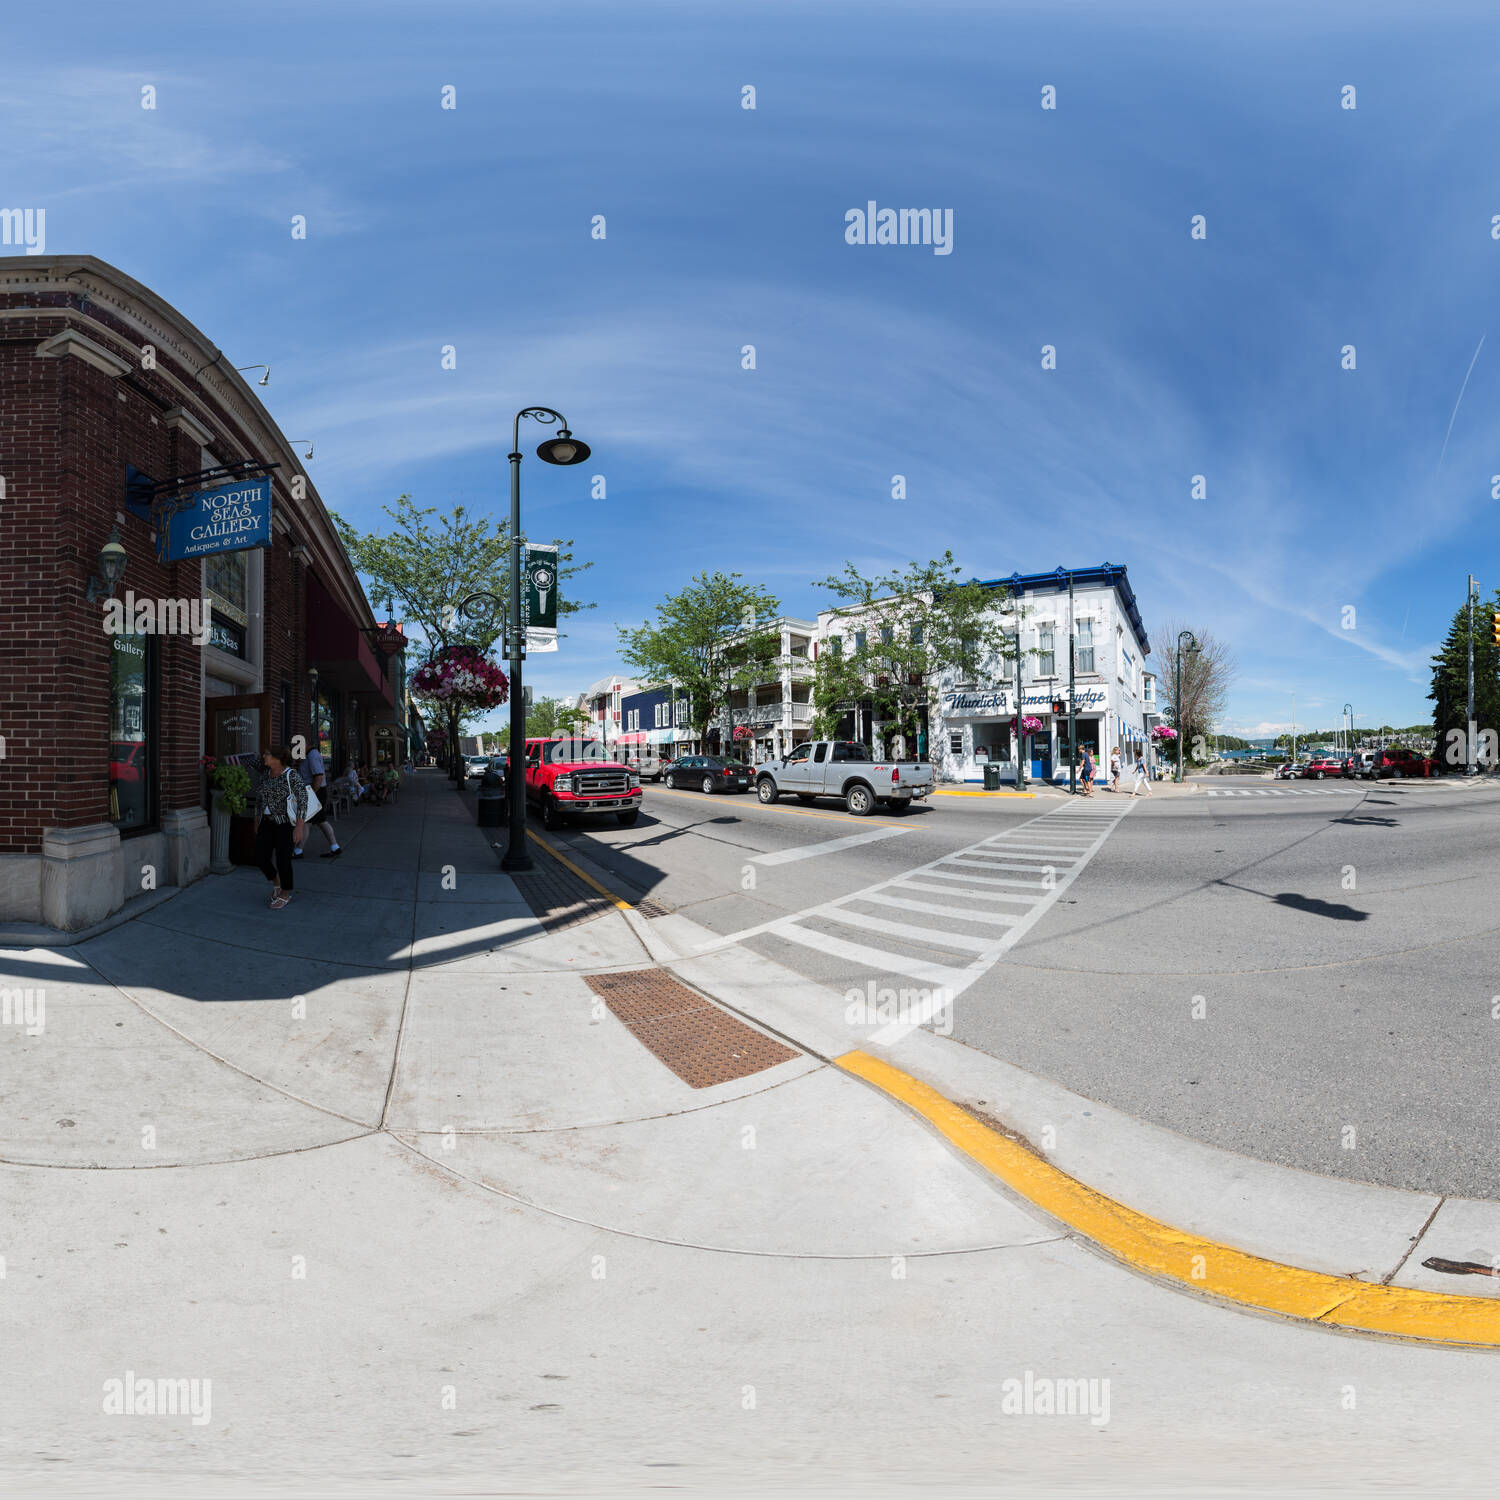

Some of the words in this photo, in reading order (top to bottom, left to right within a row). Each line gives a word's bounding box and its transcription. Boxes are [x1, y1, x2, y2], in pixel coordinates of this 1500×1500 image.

[202, 488, 262, 511] NORTH
[211, 503, 252, 522] SEAS
[190, 515, 262, 540] GALLERY
[184, 542, 220, 553] Antiques
[223, 538, 231, 546] &
[234, 536, 248, 544] Art
[113, 639, 145, 659] Gallery
[220, 631, 239, 650] Seas
[1012, 691, 1061, 705] amous
[1066, 688, 1106, 707] udge
